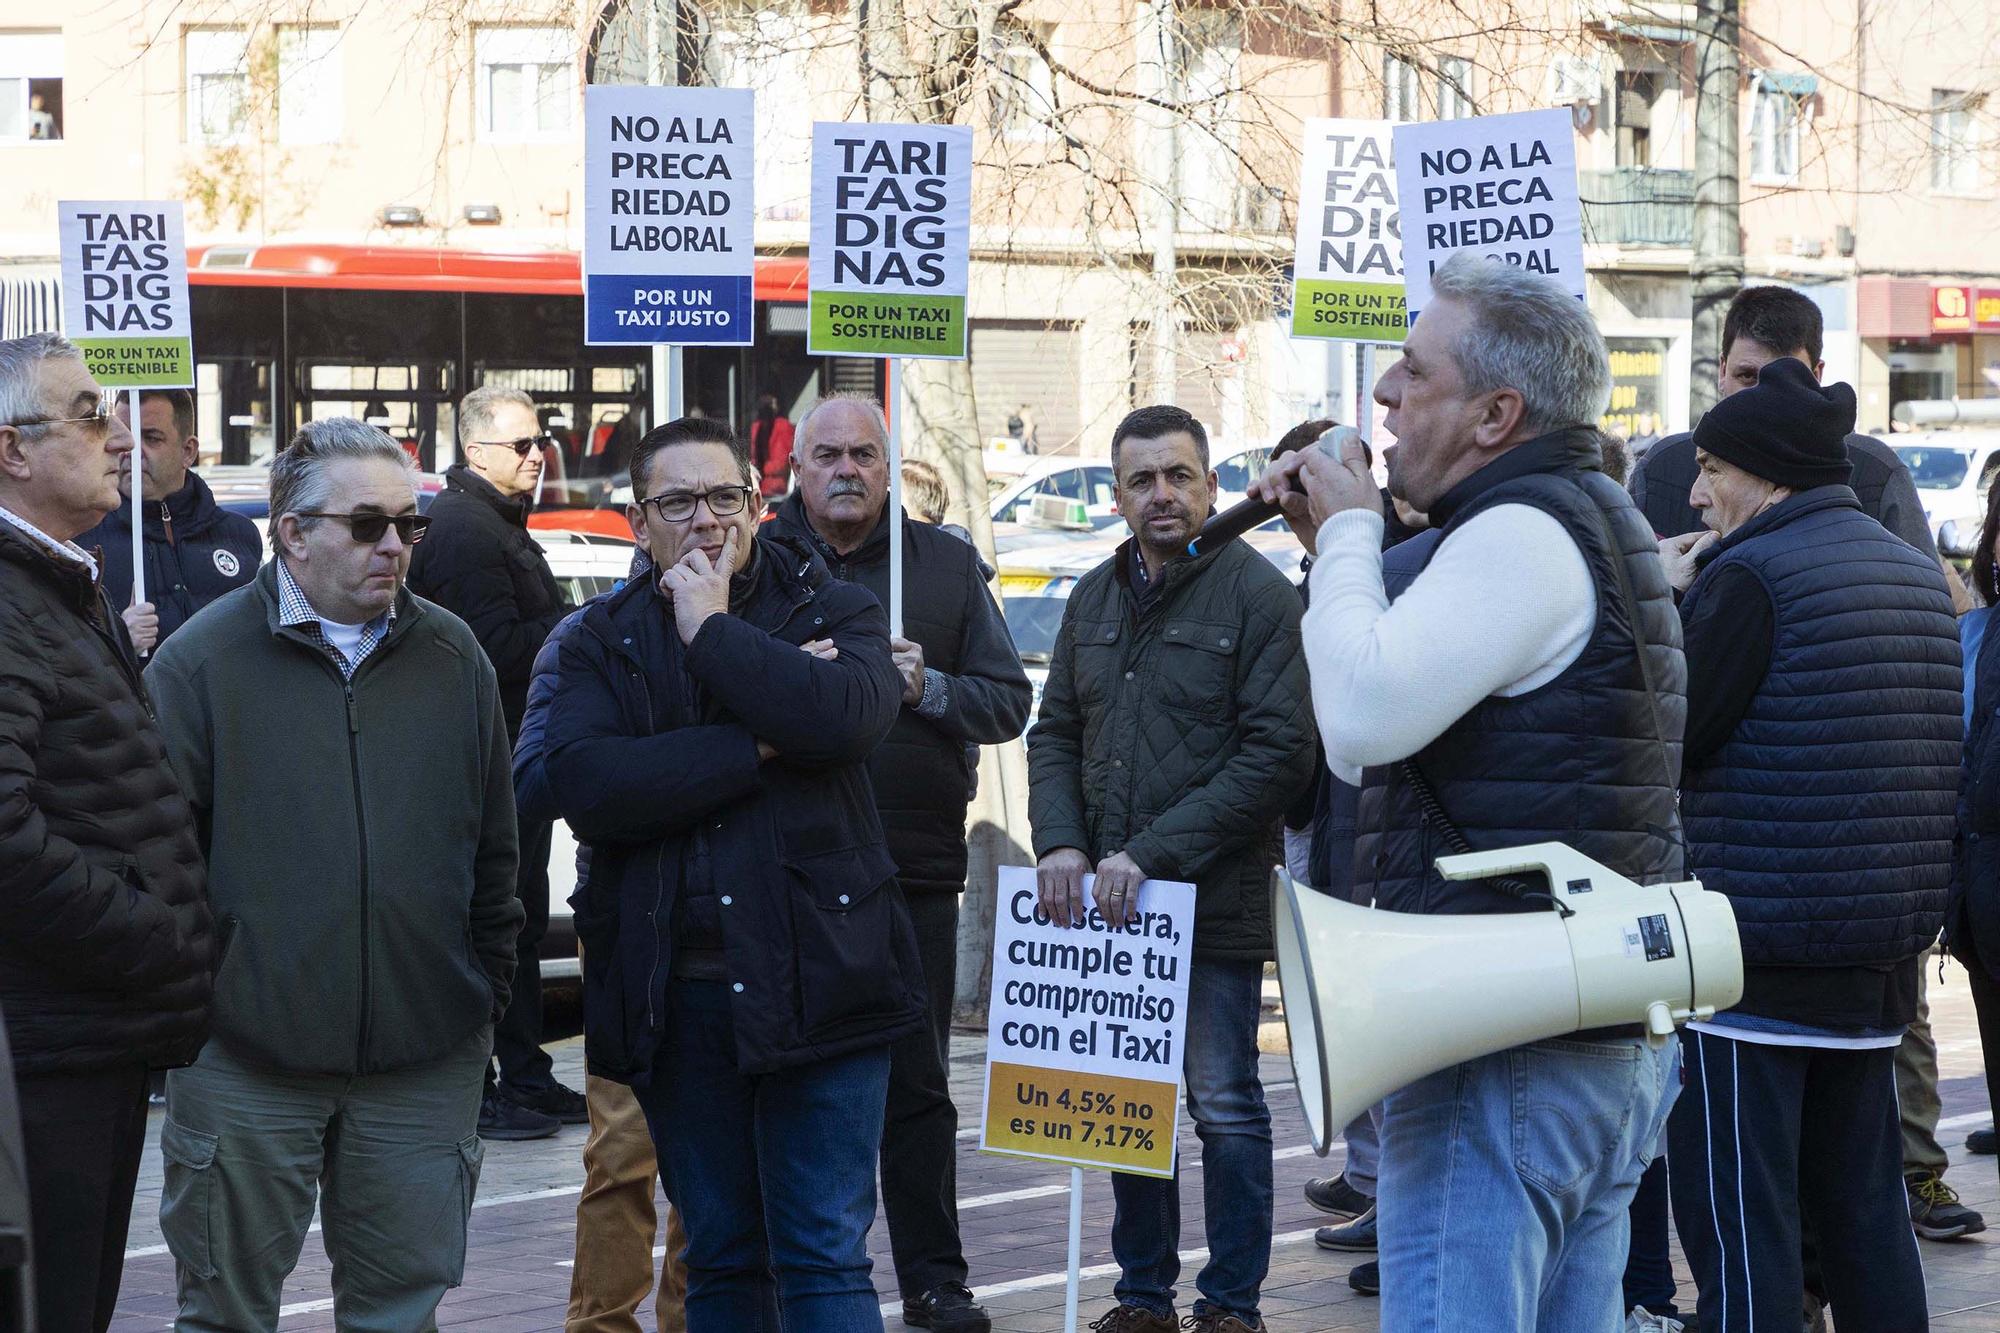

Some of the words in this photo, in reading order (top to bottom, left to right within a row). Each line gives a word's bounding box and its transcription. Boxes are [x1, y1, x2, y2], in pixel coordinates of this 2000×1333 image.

[611, 115, 660, 143] NO
[665, 117, 689, 143] A
[696, 117, 734, 144] LA
[611, 152, 732, 180] PRECA
[834, 138, 947, 176] TARI
[1326, 135, 1395, 170] TA
[1420, 148, 1472, 178] NO
[1479, 145, 1504, 172] A
[1510, 140, 1552, 169] LA
[611, 189, 731, 216] RIEDAD
[836, 175, 947, 213] FAS
[1325, 171, 1397, 206] FA
[1424, 176, 1554, 214] PRECA
[77, 213, 166, 241] TARI
[610, 225, 733, 252] LABORAL
[835, 213, 946, 250] DIG
[1427, 212, 1554, 250] RIEDAD
[81, 243, 169, 271] FAS
[834, 250, 945, 287] NAS
[1318, 240, 1404, 276] NA
[83, 273, 171, 301] DIG
[634, 289, 677, 305] POR
[682, 290, 712, 306] UN
[1312, 292, 1350, 307] POR
[1356, 294, 1382, 309] UN
[1387, 296, 1407, 310] TA
[85, 303, 173, 331] NAS
[615, 310, 661, 326] TAXI
[667, 310, 731, 326] JUSTO
[829, 304, 868, 320] POR
[874, 306, 902, 321] UN
[907, 307, 950, 322] TAXI
[832, 323, 946, 341] SOSTENIBLE
[84, 348, 116, 360] POR
[120, 348, 142, 360] UN
[146, 347, 180, 359] TAXI
[87, 362, 178, 375] SOSTENIBLE
[1007, 939, 1133, 980] cumple
[1142, 947, 1178, 982] tu
[1004, 980, 1175, 1023] compromiso
[1001, 1020, 1060, 1051] con
[1069, 1021, 1098, 1056] el
[1106, 1023, 1172, 1065] Taxi
[1016, 1082, 1049, 1108] Un
[1056, 1089, 1116, 1116] 4,5%
[1123, 1100, 1154, 1120] no
[1010, 1117, 1036, 1135] es
[1043, 1122, 1072, 1140] un
[1081, 1121, 1155, 1151] 7,17%
